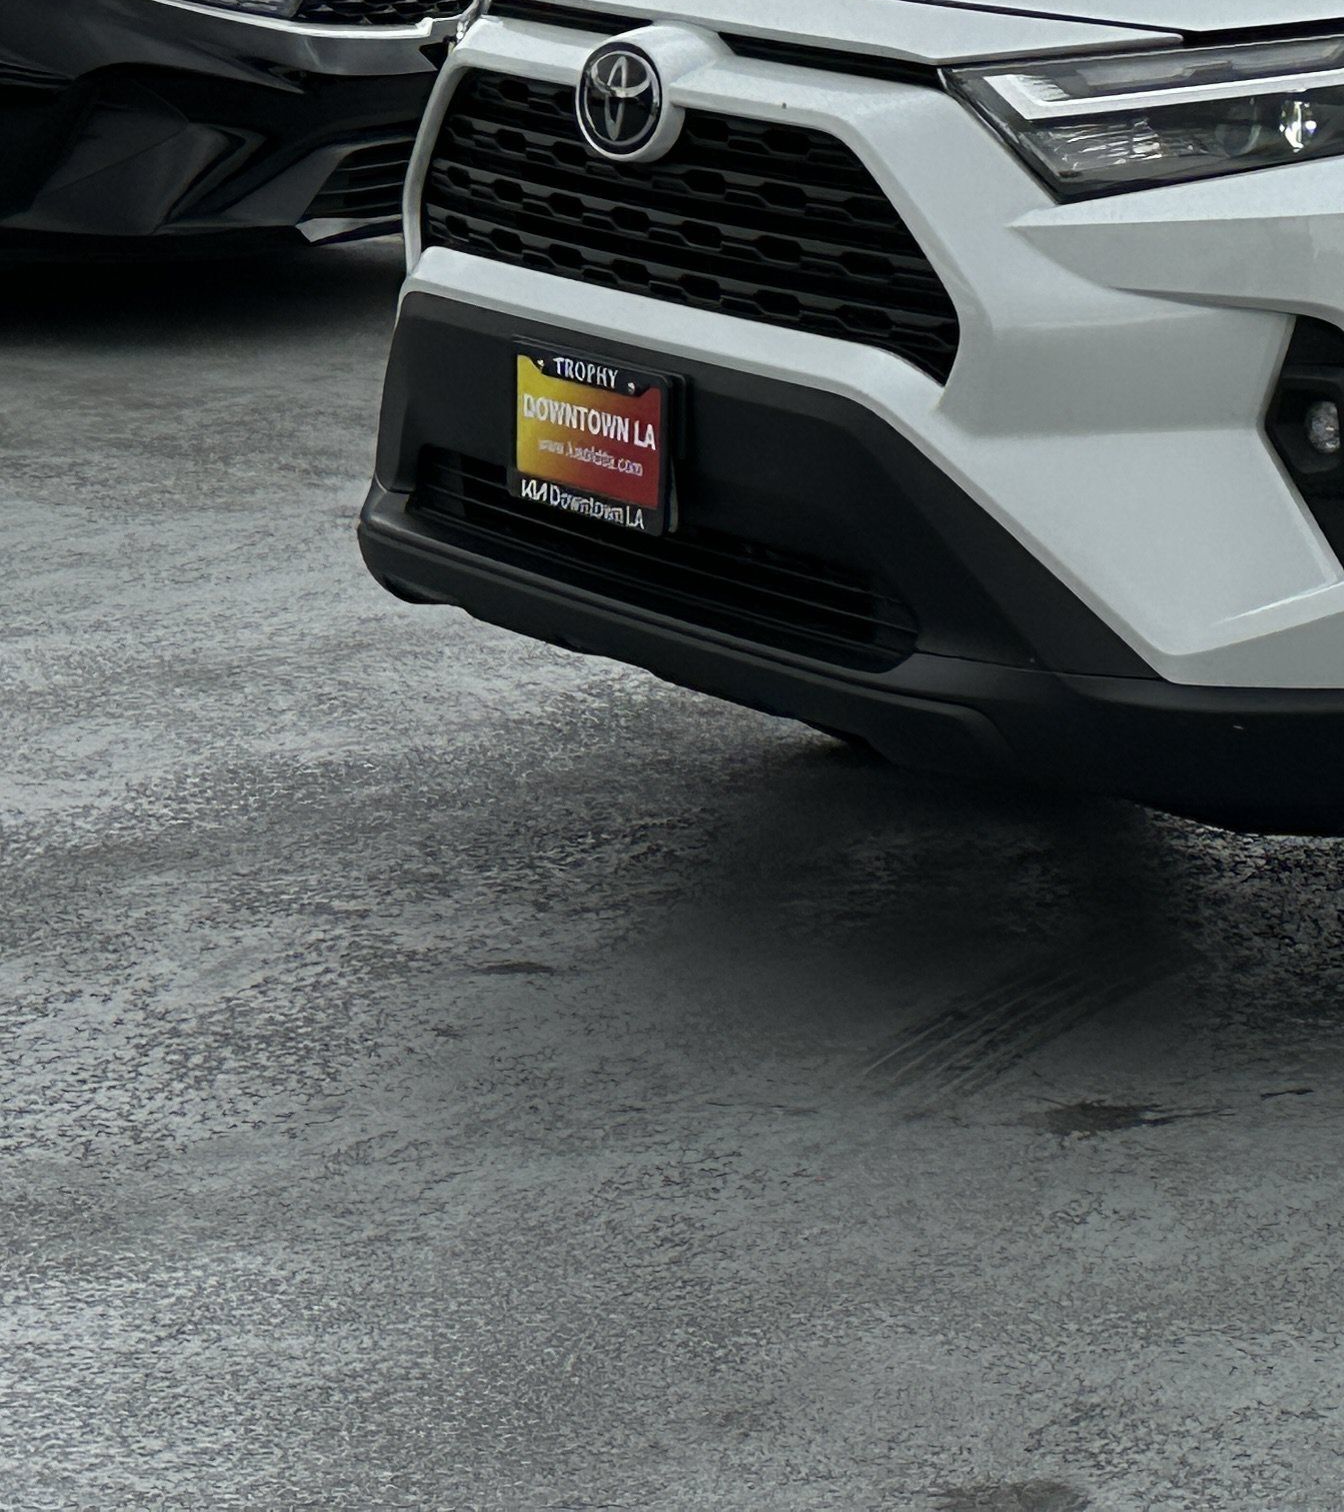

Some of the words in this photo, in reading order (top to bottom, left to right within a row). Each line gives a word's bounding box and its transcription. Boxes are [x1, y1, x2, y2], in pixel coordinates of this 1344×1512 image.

[553, 356, 619, 389] TROPHY
[523, 392, 630, 444] DOWNTOWN
[633, 420, 657, 451] LA
[521, 478, 548, 502] KIA
[549, 483, 624, 525] Downtown
[625, 505, 645, 530] LA
